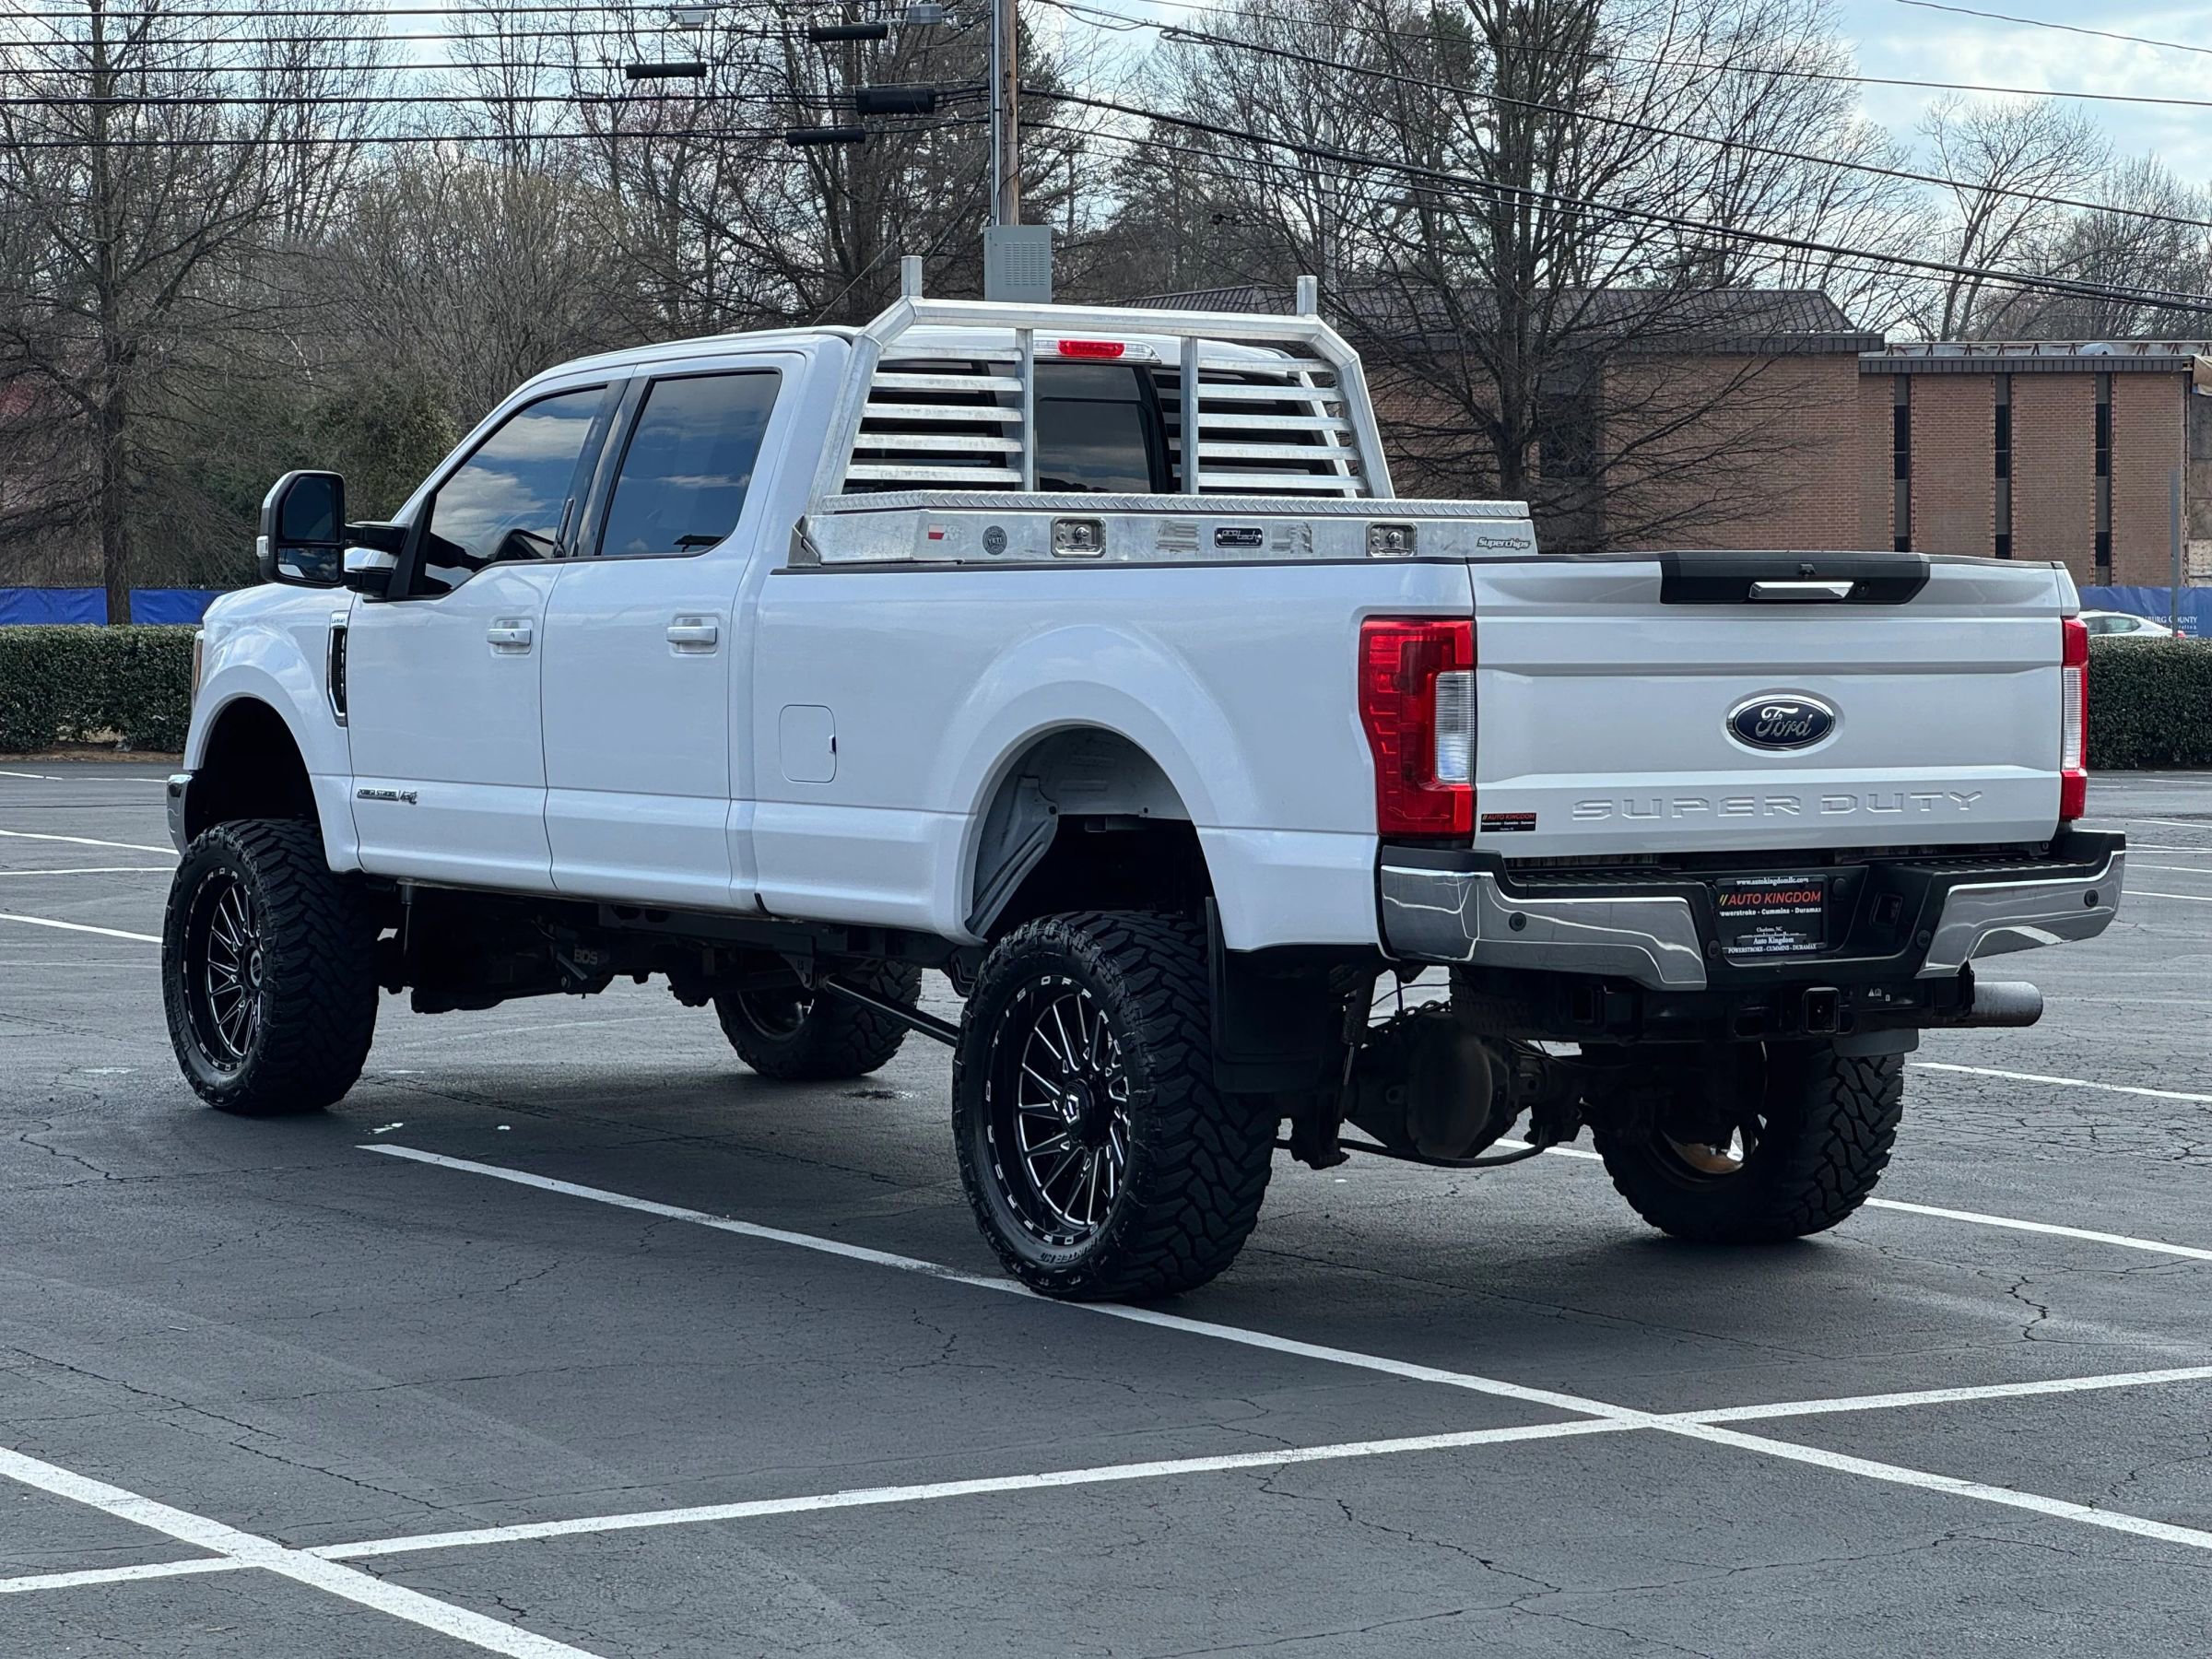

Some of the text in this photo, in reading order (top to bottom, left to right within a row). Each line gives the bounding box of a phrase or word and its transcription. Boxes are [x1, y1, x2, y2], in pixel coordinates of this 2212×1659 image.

[1477, 537, 1531, 550] Superchips
[1755, 706, 1813, 737] Ford
[1571, 791, 1983, 820] SUPER DUTY
[1728, 891, 1821, 905] AUTO KINGDOM
[1768, 936, 1794, 945] Kingdom
[573, 948, 598, 966] BDS
